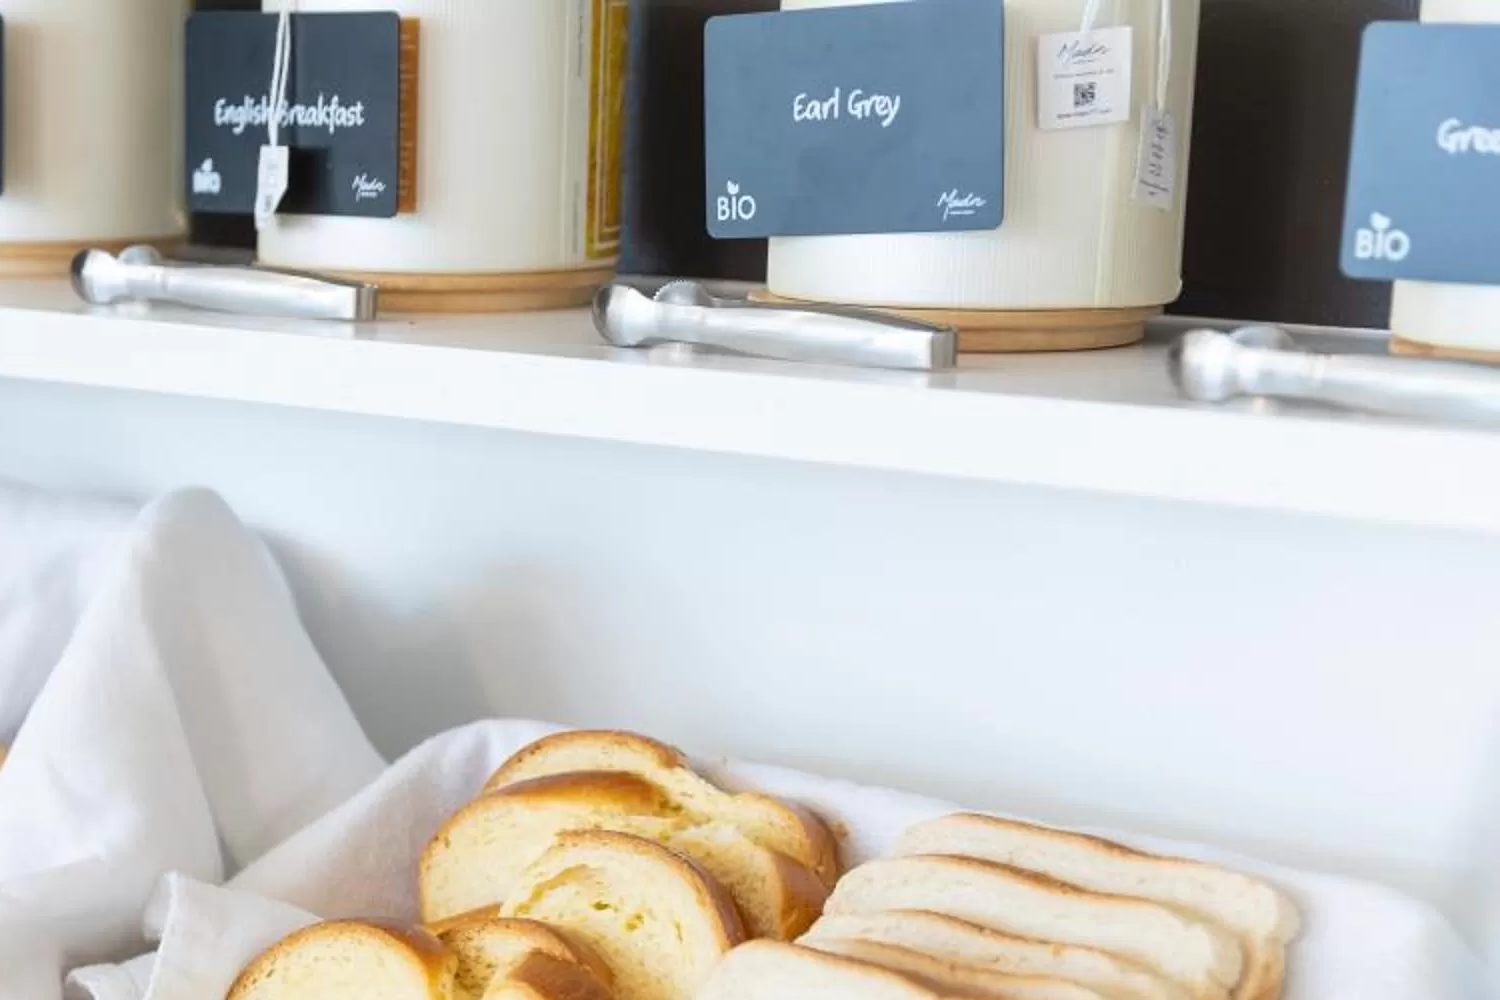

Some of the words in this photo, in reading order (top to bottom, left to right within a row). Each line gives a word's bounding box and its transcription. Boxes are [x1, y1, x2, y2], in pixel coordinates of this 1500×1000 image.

[214, 95, 276, 134] English
[278, 93, 365, 134] Breakfast
[793, 87, 840, 122] Earl
[847, 89, 901, 128] Grey
[716, 195, 757, 221] BIO
[1355, 228, 1410, 262] BIO
